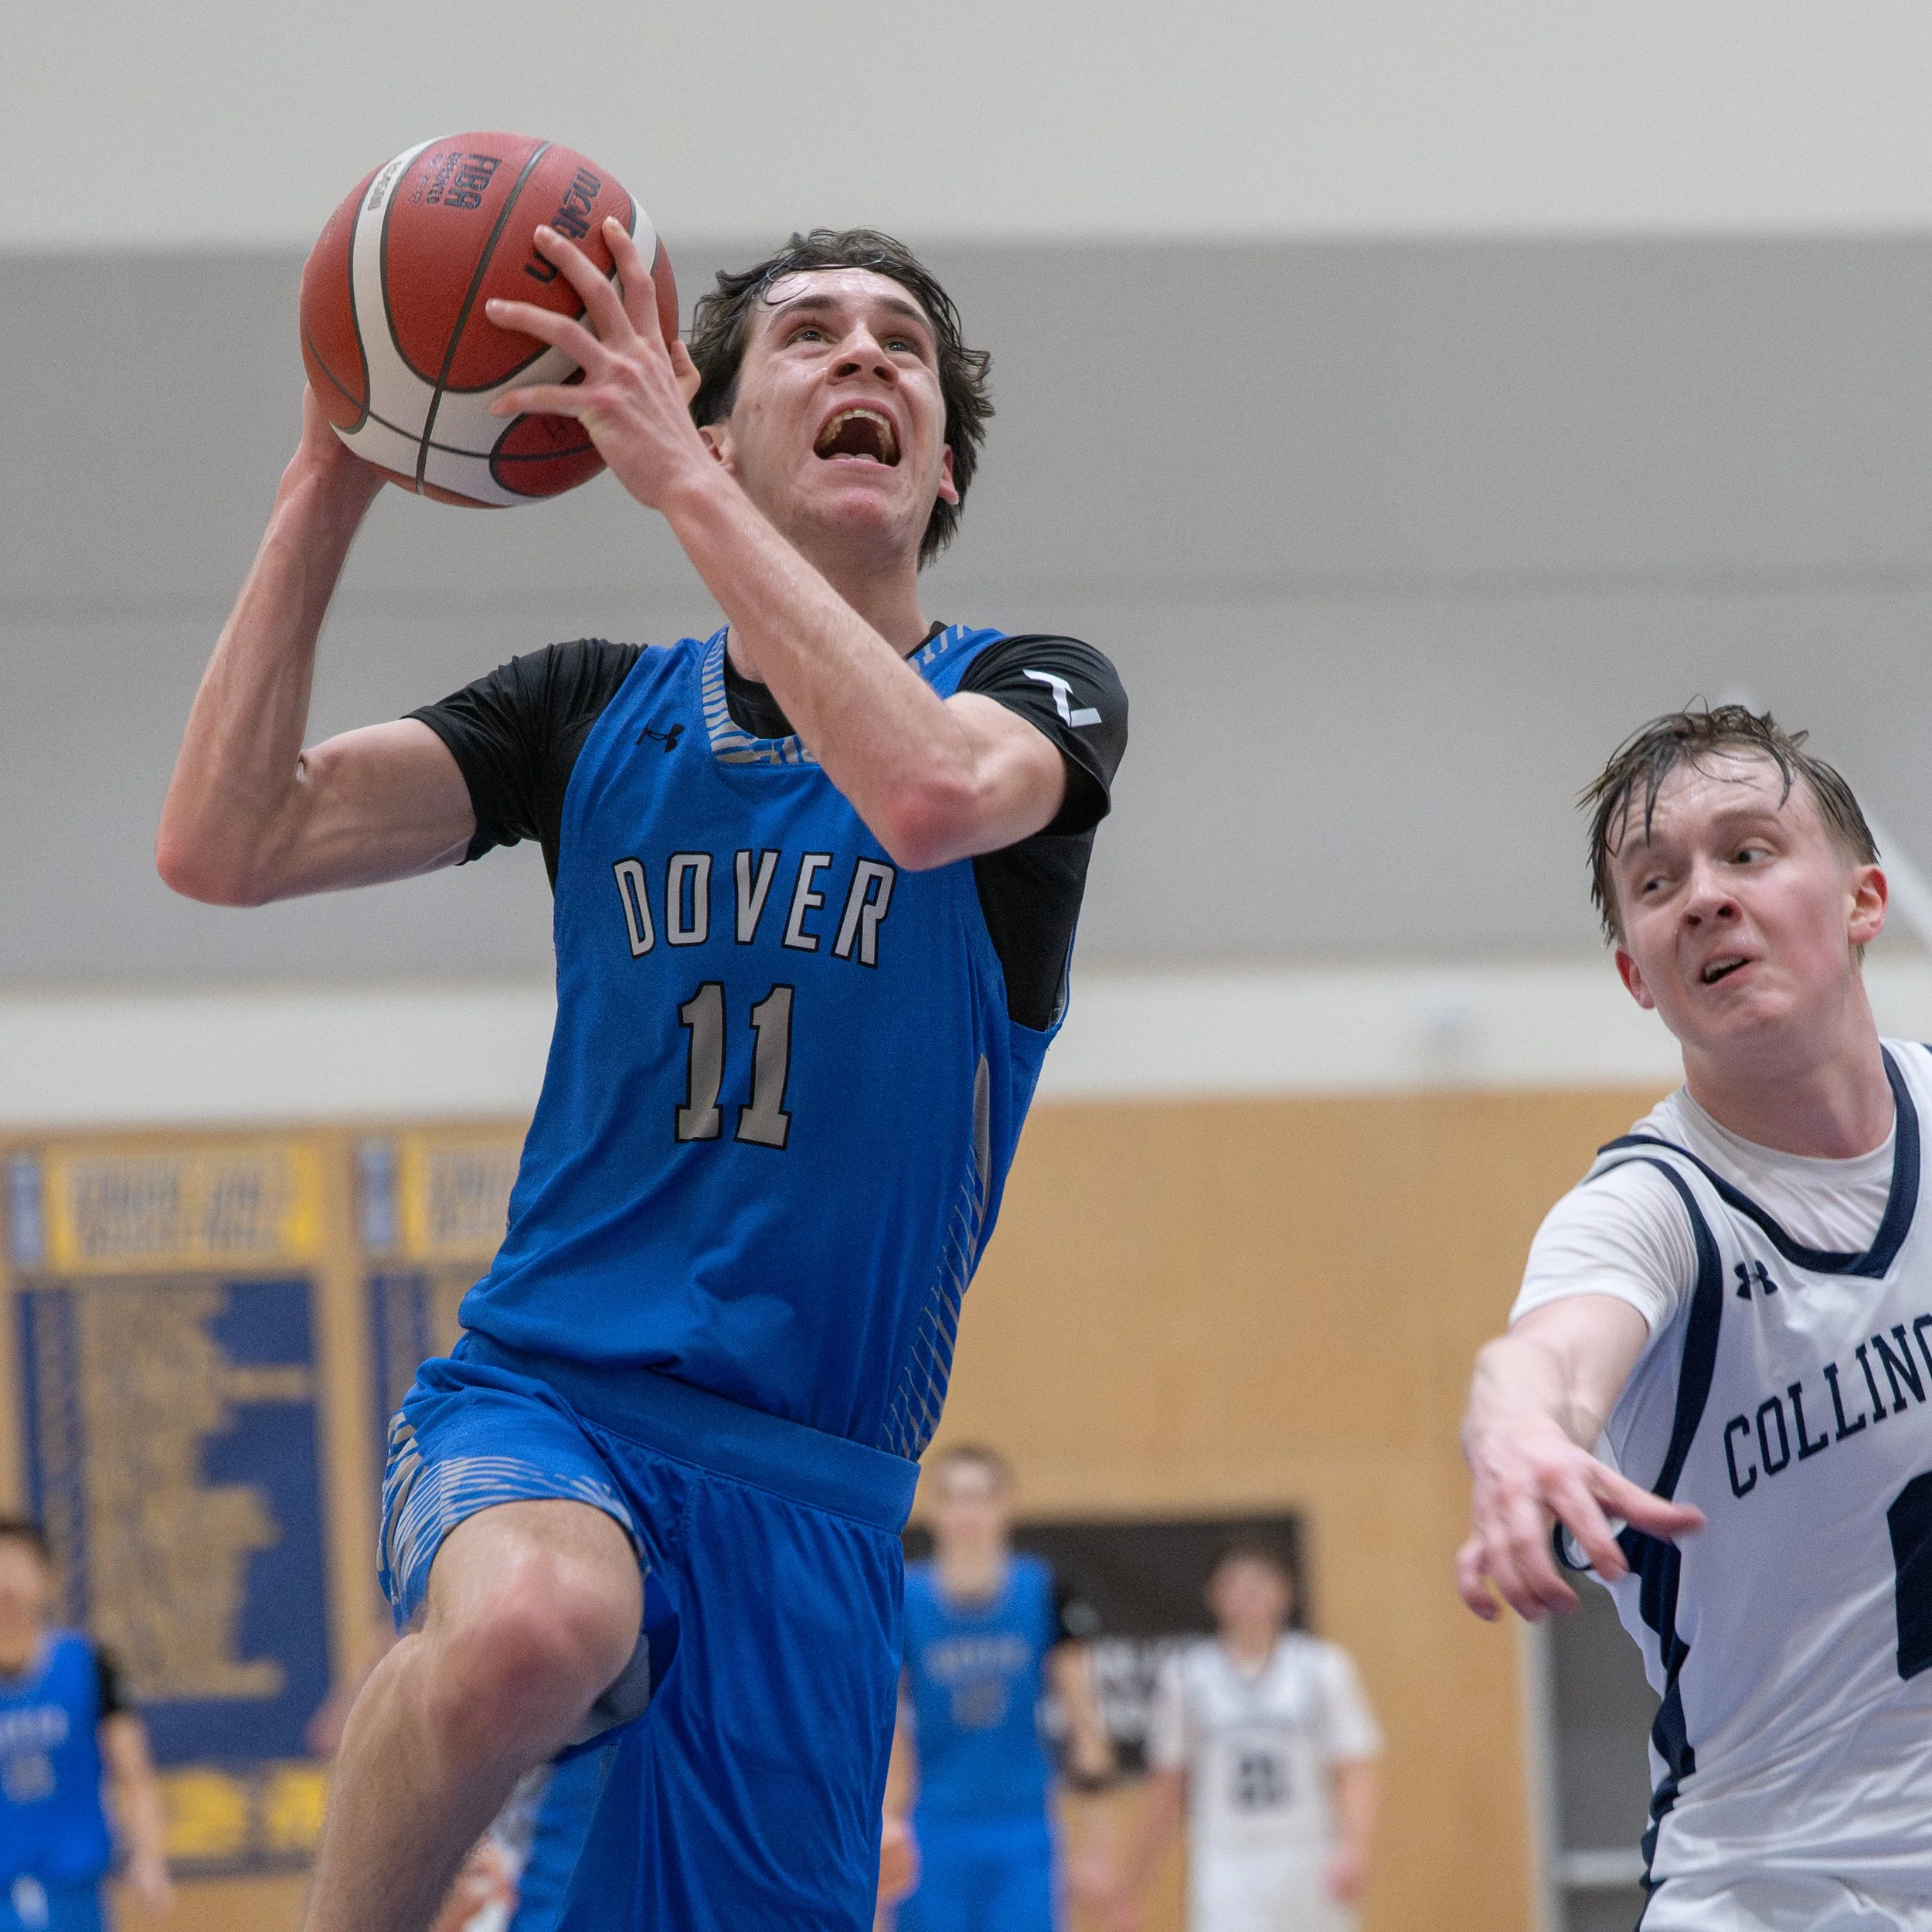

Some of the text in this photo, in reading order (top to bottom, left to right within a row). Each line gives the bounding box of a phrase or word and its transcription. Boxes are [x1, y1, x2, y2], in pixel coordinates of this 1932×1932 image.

[525, 166, 601, 284] moltn
[612, 849, 896, 970] DOVER
[675, 981, 795, 1151] 11
